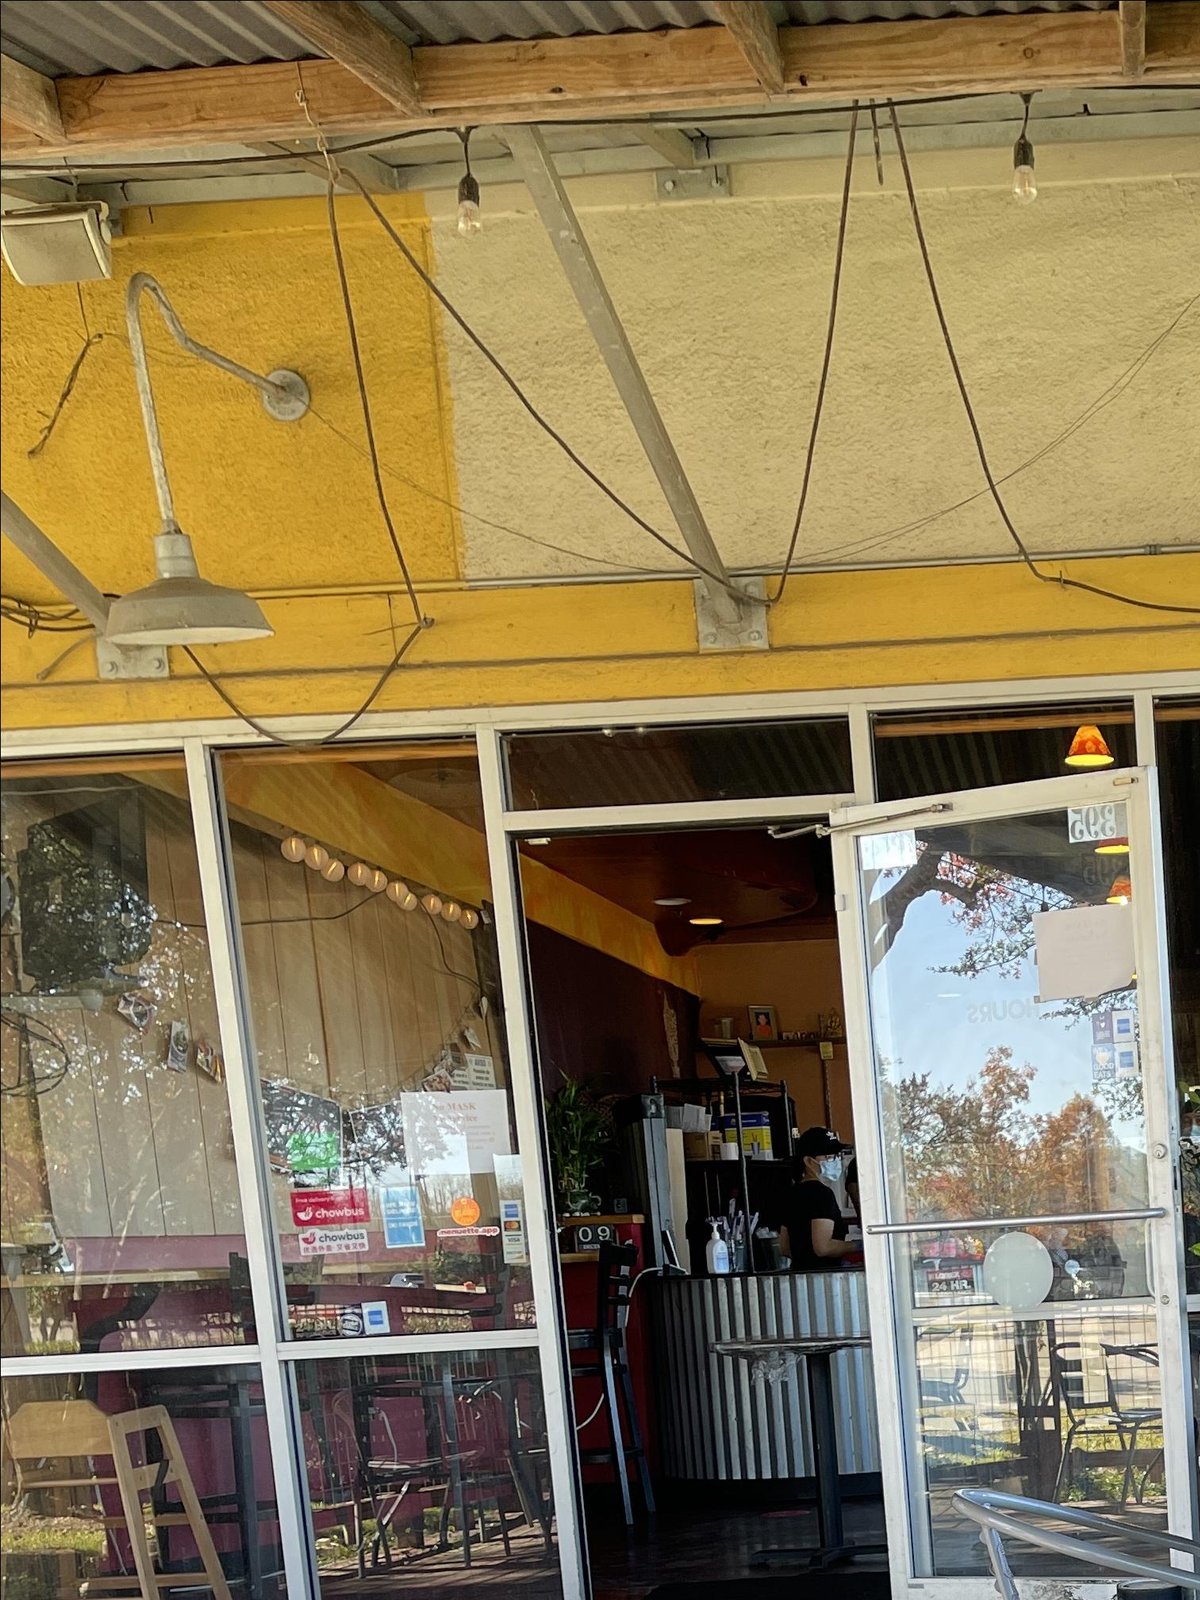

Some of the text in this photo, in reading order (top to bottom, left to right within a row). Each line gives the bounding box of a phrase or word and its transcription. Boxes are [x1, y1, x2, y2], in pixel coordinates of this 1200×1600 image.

[315, 1207, 365, 1218] chowbus
[319, 1232, 365, 1243] chowbus
[931, 1281, 948, 1292] 24
